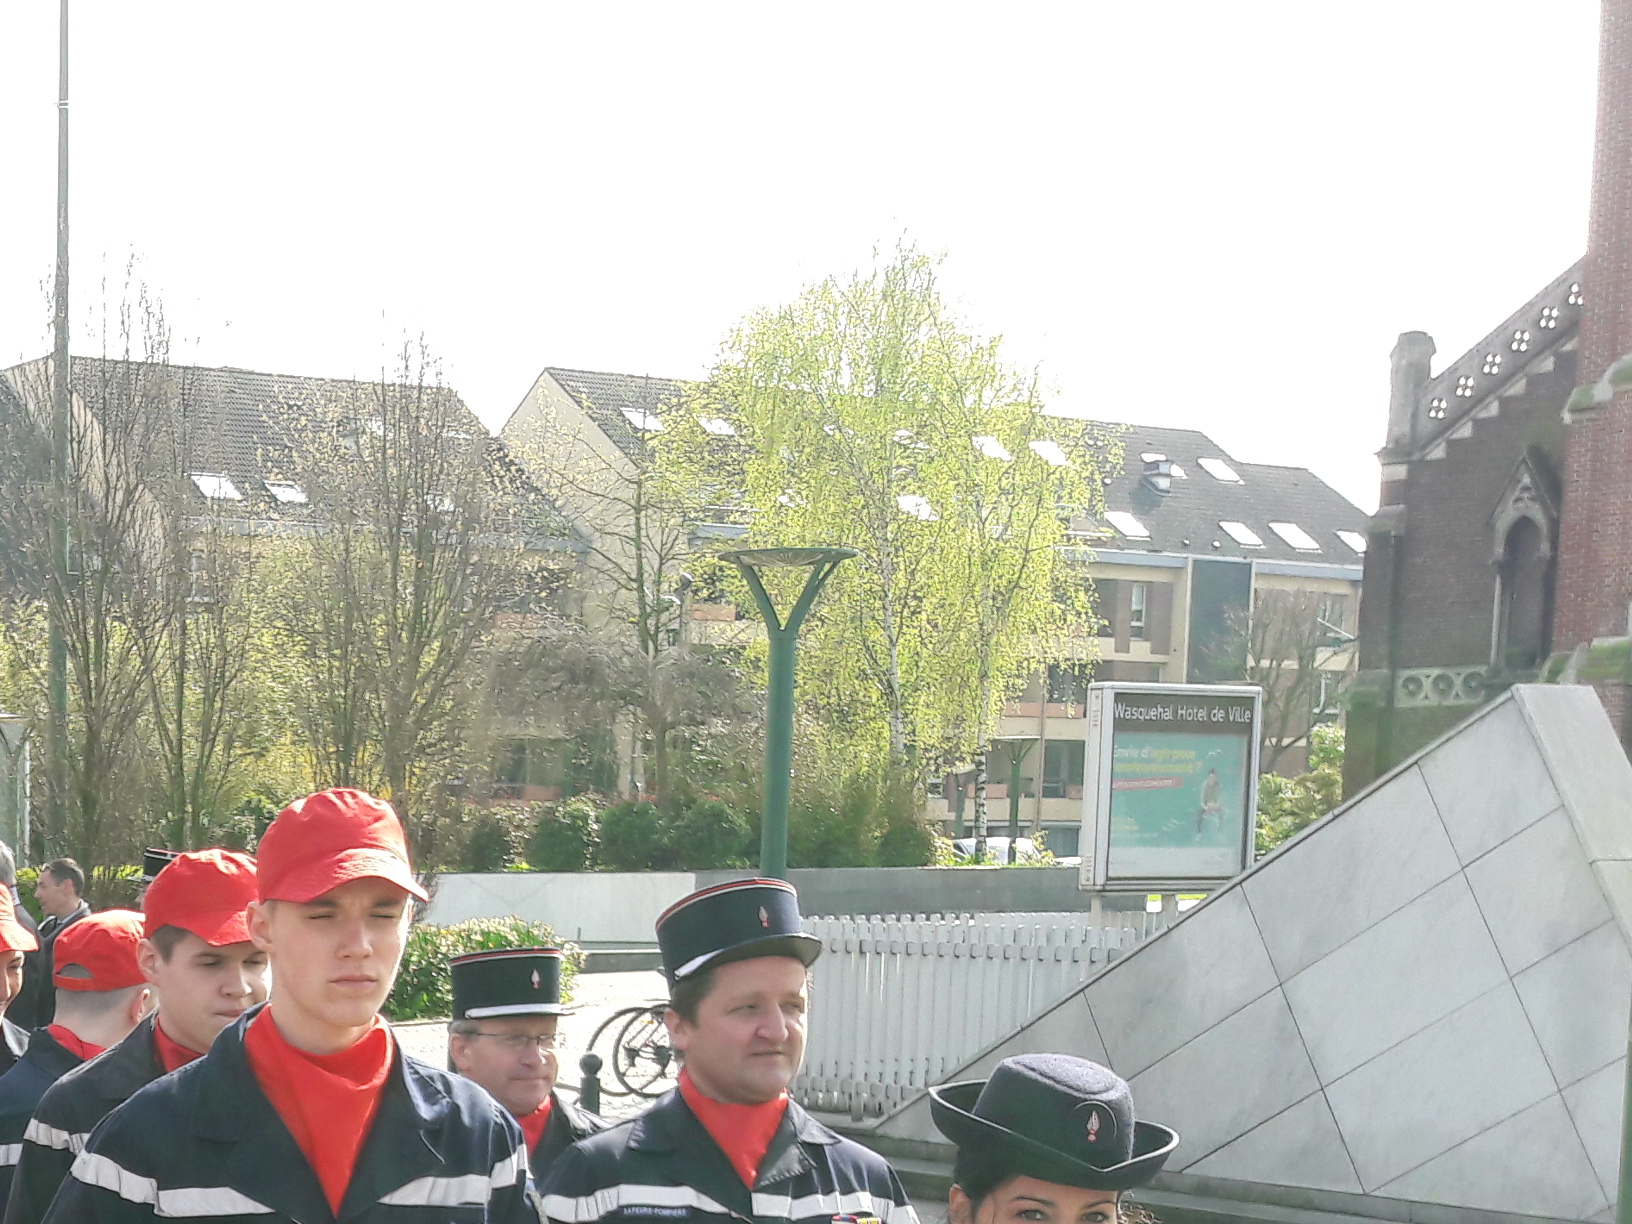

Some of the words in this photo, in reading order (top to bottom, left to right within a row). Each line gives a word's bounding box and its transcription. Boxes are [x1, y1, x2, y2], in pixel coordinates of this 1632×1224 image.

[1114, 702, 1173, 722] Wasquehal
[1211, 706, 1225, 722] de
[1228, 706, 1252, 723] Ville
